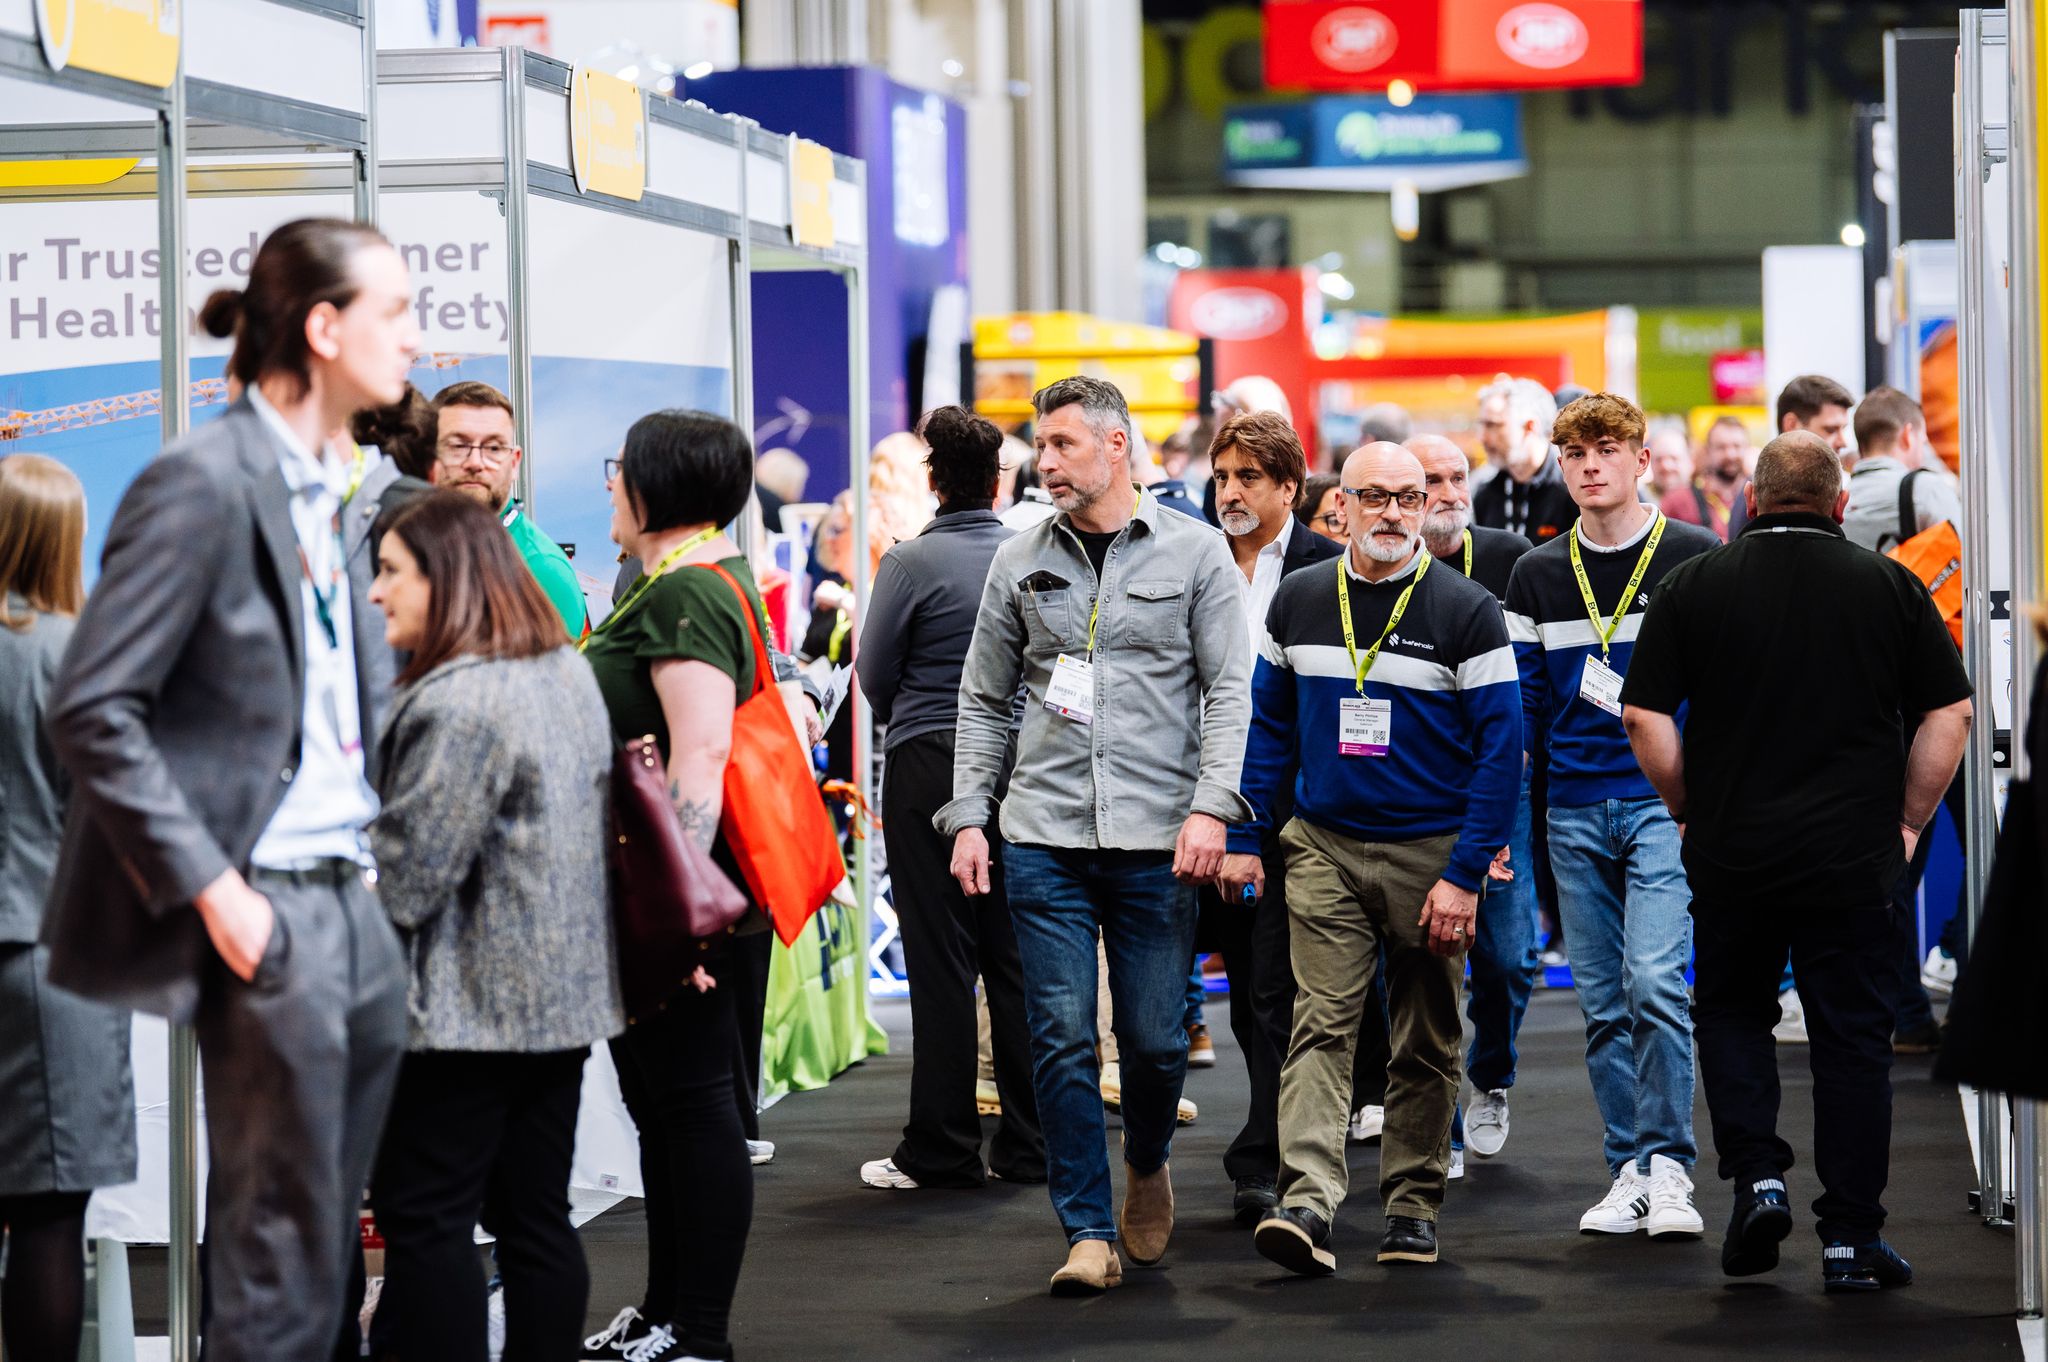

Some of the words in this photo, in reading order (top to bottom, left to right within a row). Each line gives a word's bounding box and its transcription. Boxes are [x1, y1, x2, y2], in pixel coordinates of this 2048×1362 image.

[44, 232, 258, 281] Trused
[414, 286, 508, 342] fety
[1401, 638, 1435, 650] Safehold
[1752, 1178, 1786, 1194] PUMA
[1823, 1246, 1855, 1260] PUMA
